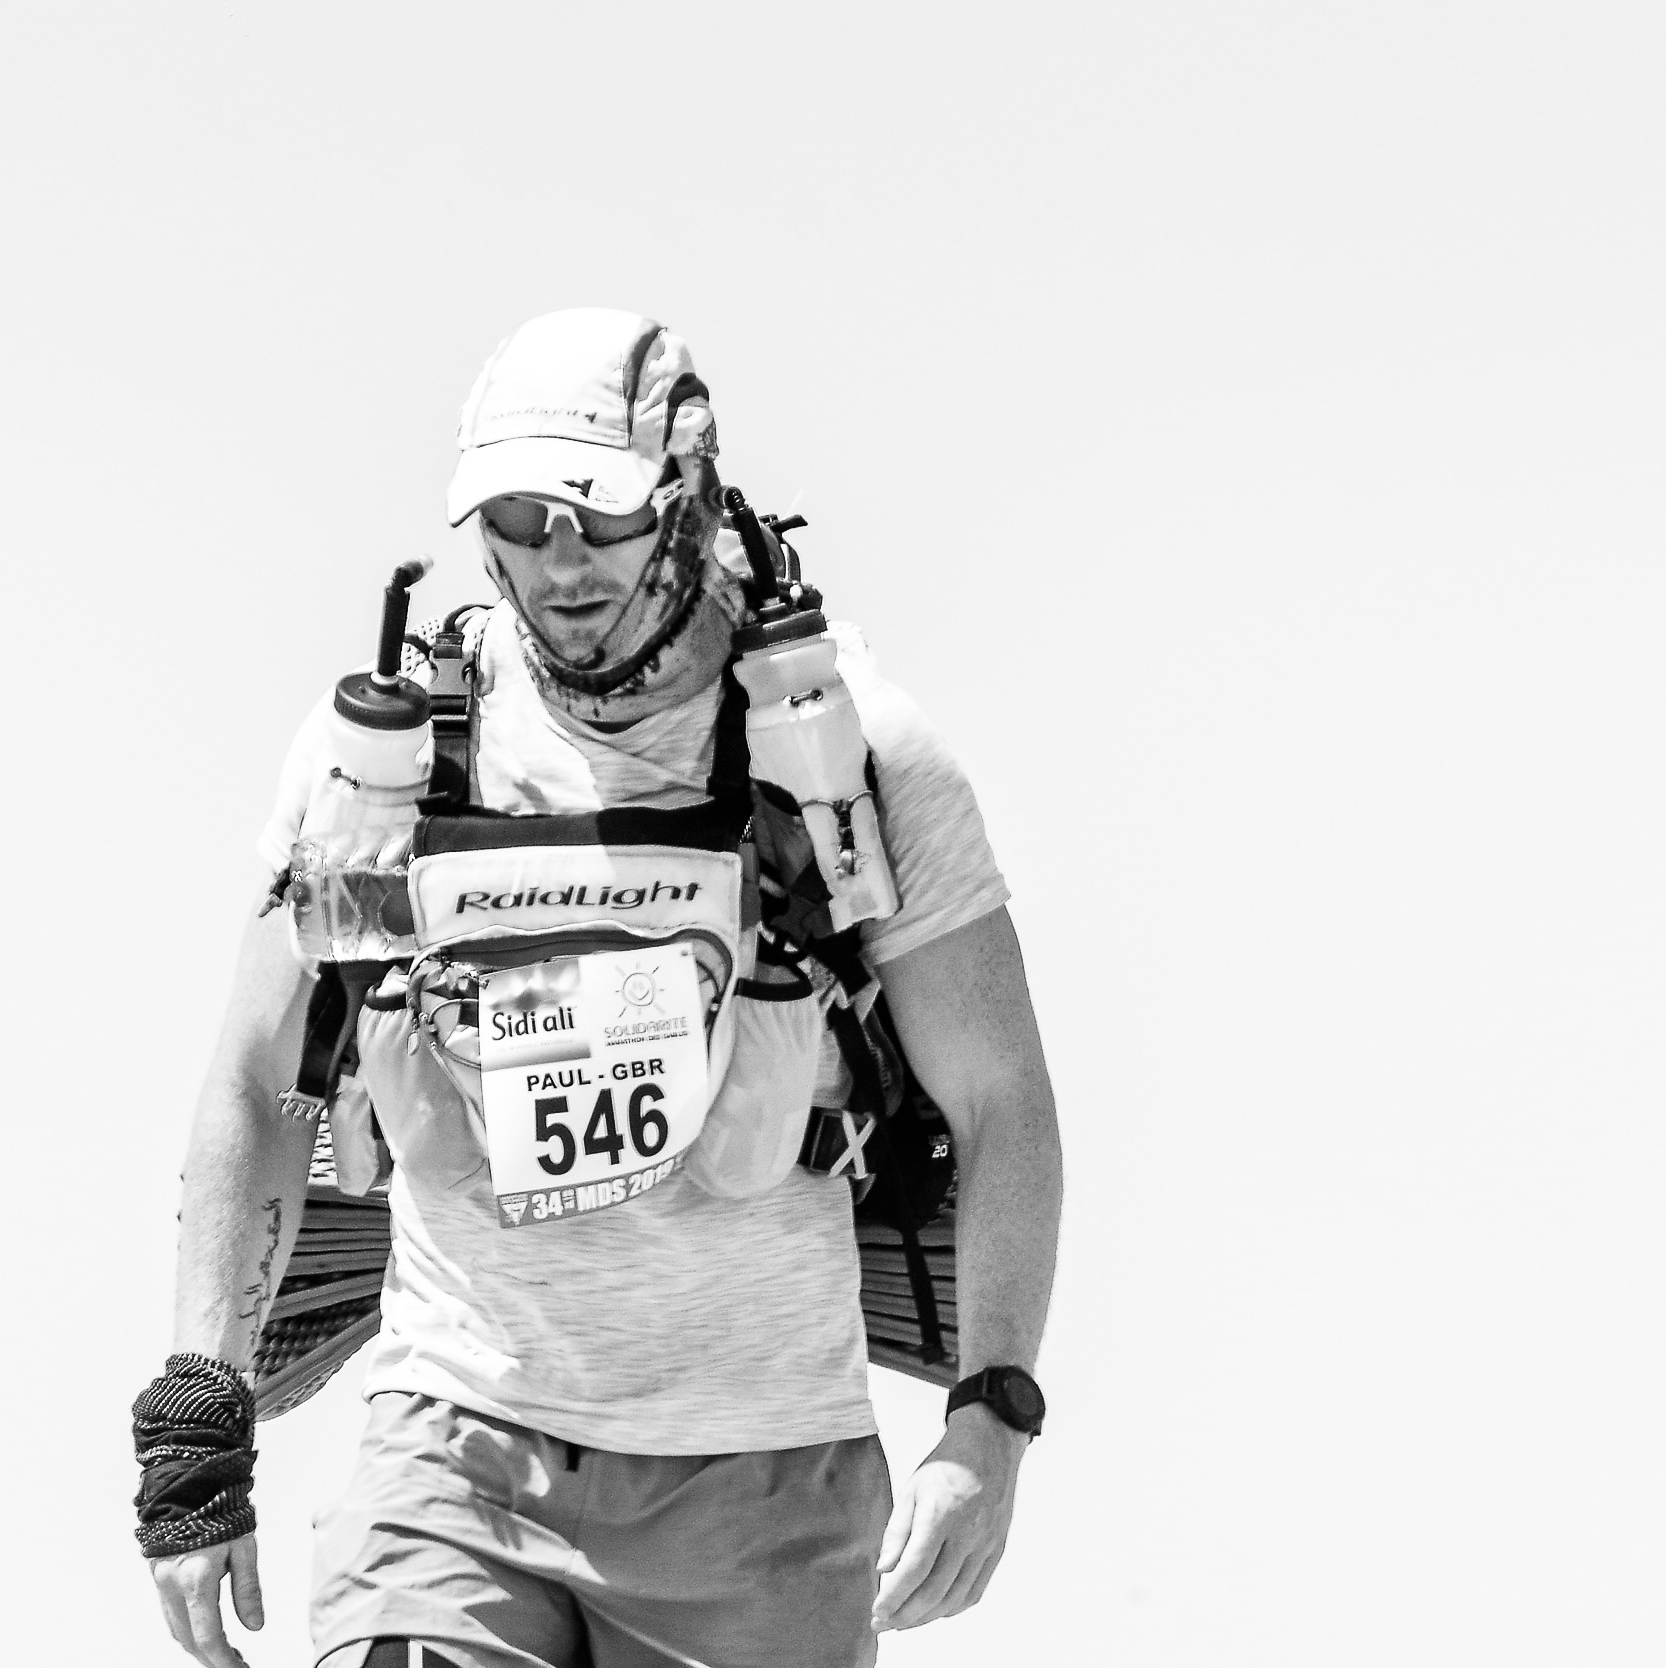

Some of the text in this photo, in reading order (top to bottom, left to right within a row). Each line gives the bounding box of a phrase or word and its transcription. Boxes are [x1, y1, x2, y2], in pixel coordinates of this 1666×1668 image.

[455, 880, 702, 914] RaidLight
[492, 1006, 576, 1041] Sidi ali
[526, 1068, 592, 1092] PAUL
[612, 1058, 665, 1081] GBR
[534, 1083, 669, 1176] 546
[931, 1144, 949, 1159] 20
[532, 1191, 564, 1219] 34
[575, 1179, 627, 1211] MDS
